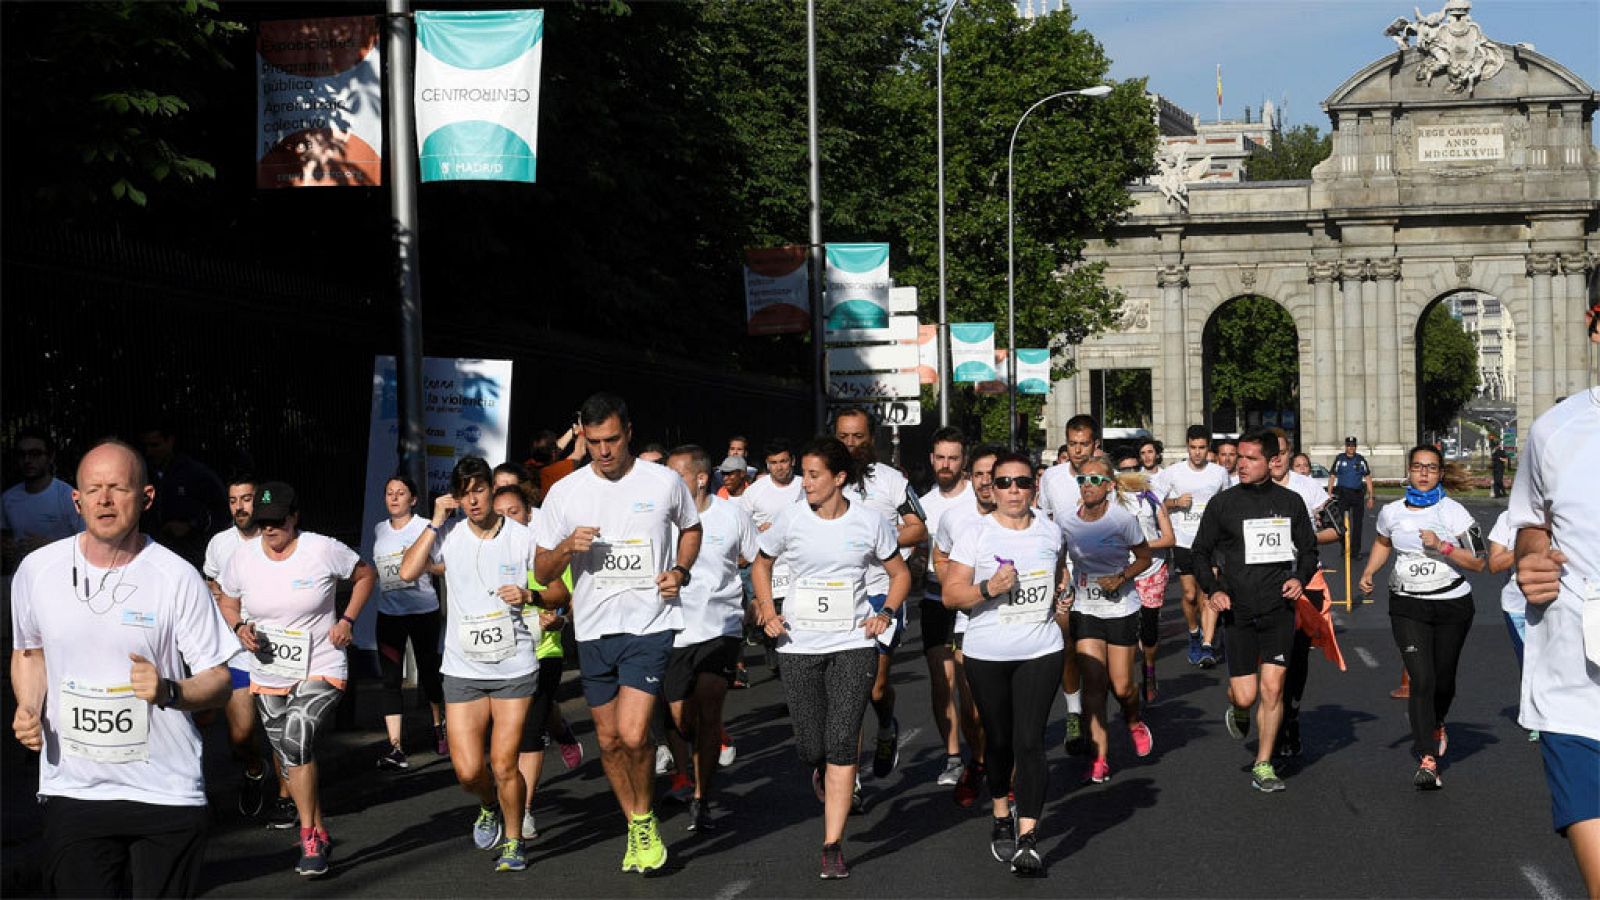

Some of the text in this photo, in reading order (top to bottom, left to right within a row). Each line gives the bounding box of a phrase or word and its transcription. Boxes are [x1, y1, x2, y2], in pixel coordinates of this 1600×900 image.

[263, 79, 313, 94] público
[1446, 138, 1478, 147] ANNO
[456, 163, 504, 174] MADRID
[1256, 532, 1282, 547] 761
[605, 554, 642, 571] 802
[1409, 562, 1437, 577] 967
[1008, 585, 1048, 606] 1887
[818, 596, 829, 613] 5
[470, 627, 503, 645] 763
[71, 706, 134, 734] 1556
